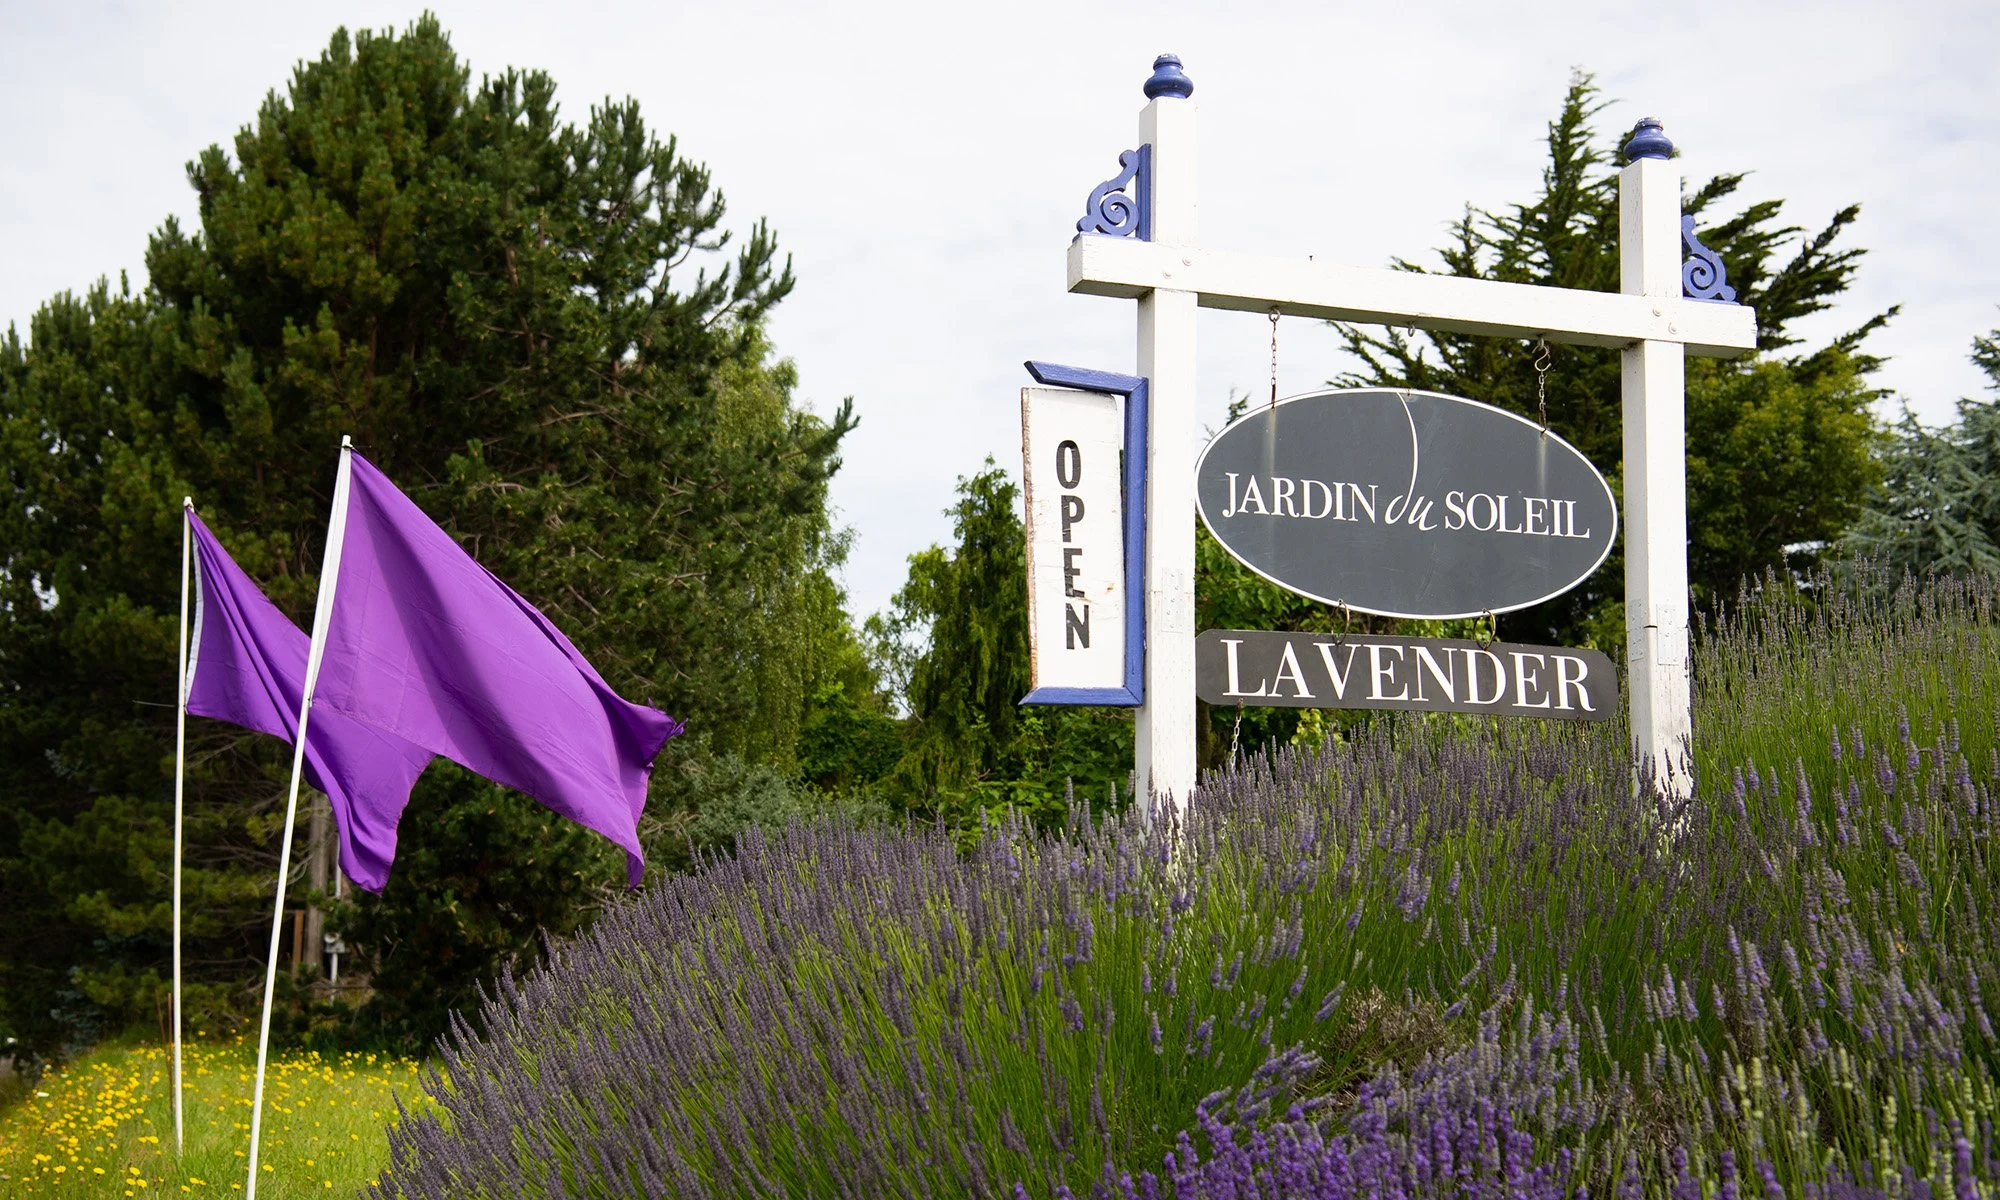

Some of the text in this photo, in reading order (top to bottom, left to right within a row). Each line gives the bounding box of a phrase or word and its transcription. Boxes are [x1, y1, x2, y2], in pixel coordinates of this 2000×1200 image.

[1222, 472, 1379, 524] JARDIN
[1444, 490, 1590, 539] SOLEIL
[1055, 439, 1090, 650] OPEN
[1220, 639, 1597, 712] LAVENDER
